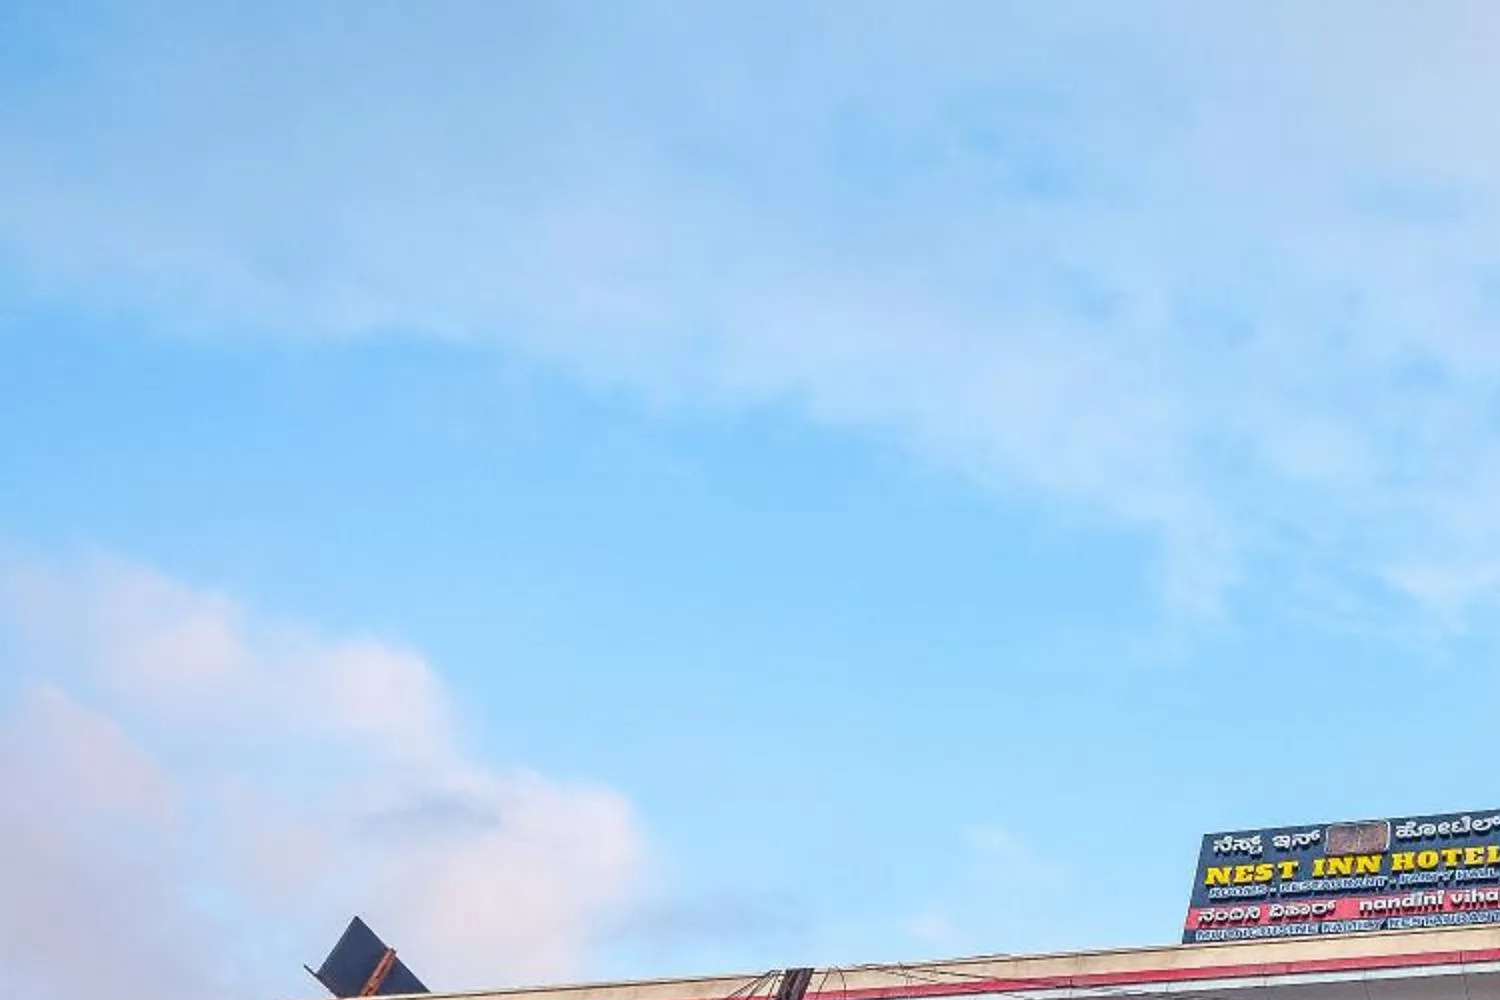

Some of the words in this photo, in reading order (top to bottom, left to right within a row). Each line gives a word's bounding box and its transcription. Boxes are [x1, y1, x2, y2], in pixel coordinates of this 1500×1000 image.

[1203, 860, 1299, 885] NEST
[1312, 853, 1383, 877] INN
[1359, 889, 1445, 911] nandini
